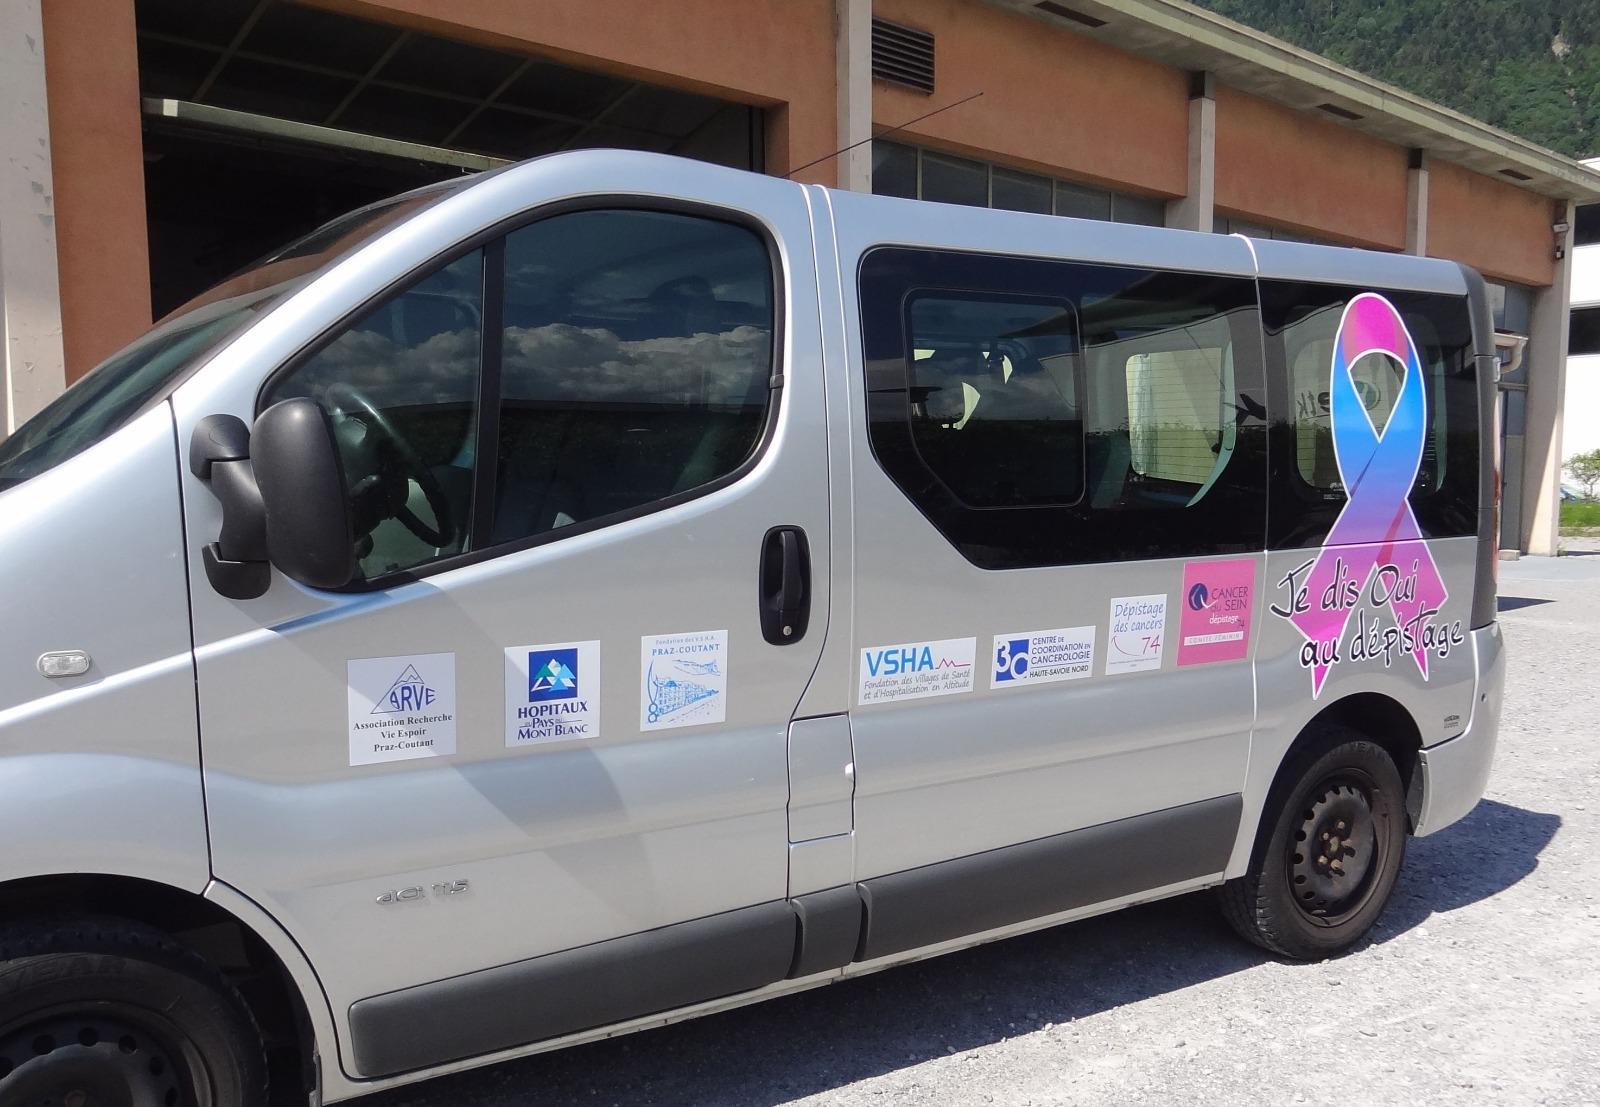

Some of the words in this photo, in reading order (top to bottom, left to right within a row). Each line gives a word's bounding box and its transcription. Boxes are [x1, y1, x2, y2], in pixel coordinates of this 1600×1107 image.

[1211, 586, 1248, 600] CANCER
[1270, 557, 1316, 618] Je
[1321, 557, 1360, 610] dis
[1370, 559, 1418, 607] Oui
[1115, 601, 1164, 620] Dépistage
[1225, 599, 1247, 612] SEIN
[1114, 621, 1128, 633] des
[1130, 618, 1163, 632] cancers
[1032, 636, 1057, 646] CENTRE
[1301, 639, 1341, 667] au
[1350, 602, 1464, 668] dépistage
[652, 643, 720, 656] PRAZ-COUTANT
[1032, 642, 1084, 655] COORDINATION
[1142, 634, 1160, 655] 74
[866, 646, 934, 677] VSHA
[1031, 651, 1090, 665] CANCEROLOGIE
[1029, 666, 1070, 678] HAUTE-SAVOIE
[1072, 664, 1089, 673] NORD
[864, 678, 899, 690] Fondation
[901, 676, 912, 686] des
[914, 673, 939, 687] Villages
[941, 671, 950, 681] de
[952, 670, 970, 681] Santé
[864, 691, 871, 700] et
[931, 684, 940, 692] en
[943, 679, 970, 690] Altitude
[389, 684, 436, 712] ARVE
[517, 700, 588, 719] HOPITAUX
[353, 718, 405, 730] Association
[407, 713, 453, 726] Recherche
[381, 729, 395, 739] Vie
[397, 727, 427, 740] Espoir
[518, 727, 552, 740] MONT
[555, 724, 588, 736] BLANC
[373, 738, 434, 752] Praz-Coutant
